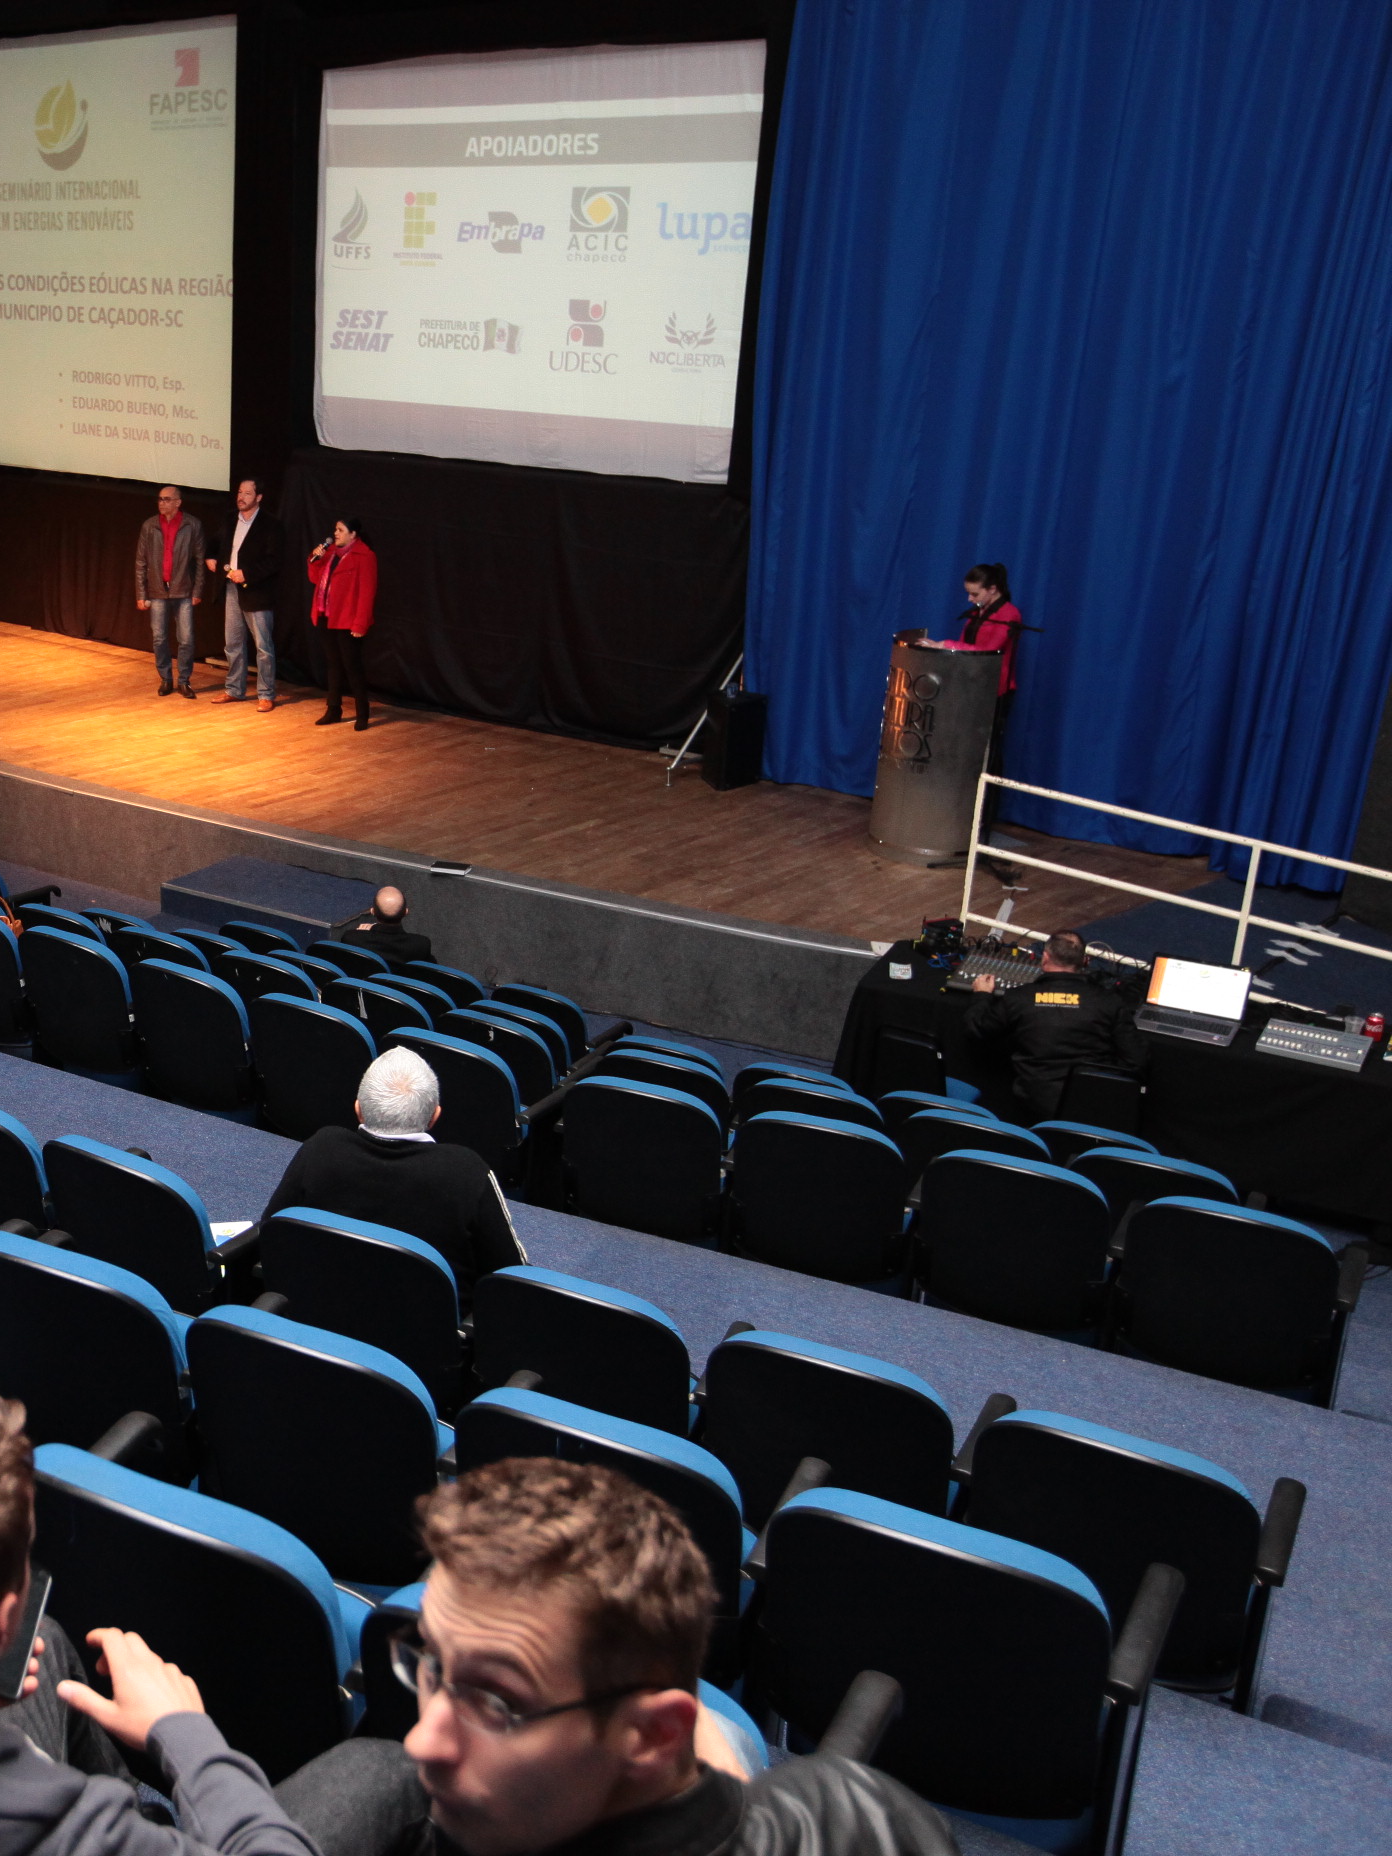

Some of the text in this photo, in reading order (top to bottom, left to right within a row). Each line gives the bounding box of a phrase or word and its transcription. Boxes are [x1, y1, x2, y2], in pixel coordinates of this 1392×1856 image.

[149, 88, 228, 115] FAPESC
[465, 133, 599, 157] APOIADORES
[55, 179, 141, 201] INTERNACIONAL
[13, 211, 64, 231] ENERGIAS
[67, 207, 134, 231] RENOVÁVEIS
[656, 201, 751, 256] lupa
[456, 219, 546, 243] Embrapa
[567, 233, 629, 252] ACIC
[334, 244, 371, 260] UFFS
[7, 272, 86, 297] CONDIÇÕES
[89, 272, 148, 296] EÓLICAS
[151, 277, 175, 296] NA
[66, 306, 85, 324] DE
[88, 307, 184, 329] CAÇADOR-SC
[336, 308, 389, 331] SEST
[419, 318, 481, 332] PREFEITURA DE
[330, 330, 394, 353] SENAT
[418, 332, 480, 351] CHAPECÓ
[549, 350, 618, 375] UDESC
[72, 370, 185, 393] RODRIGO VITTO, Esp.
[72, 396, 199, 420] EDUARDO BUENO, Msc.
[72, 422, 225, 450] LIANE DA SILVA BUENO, Dra.
